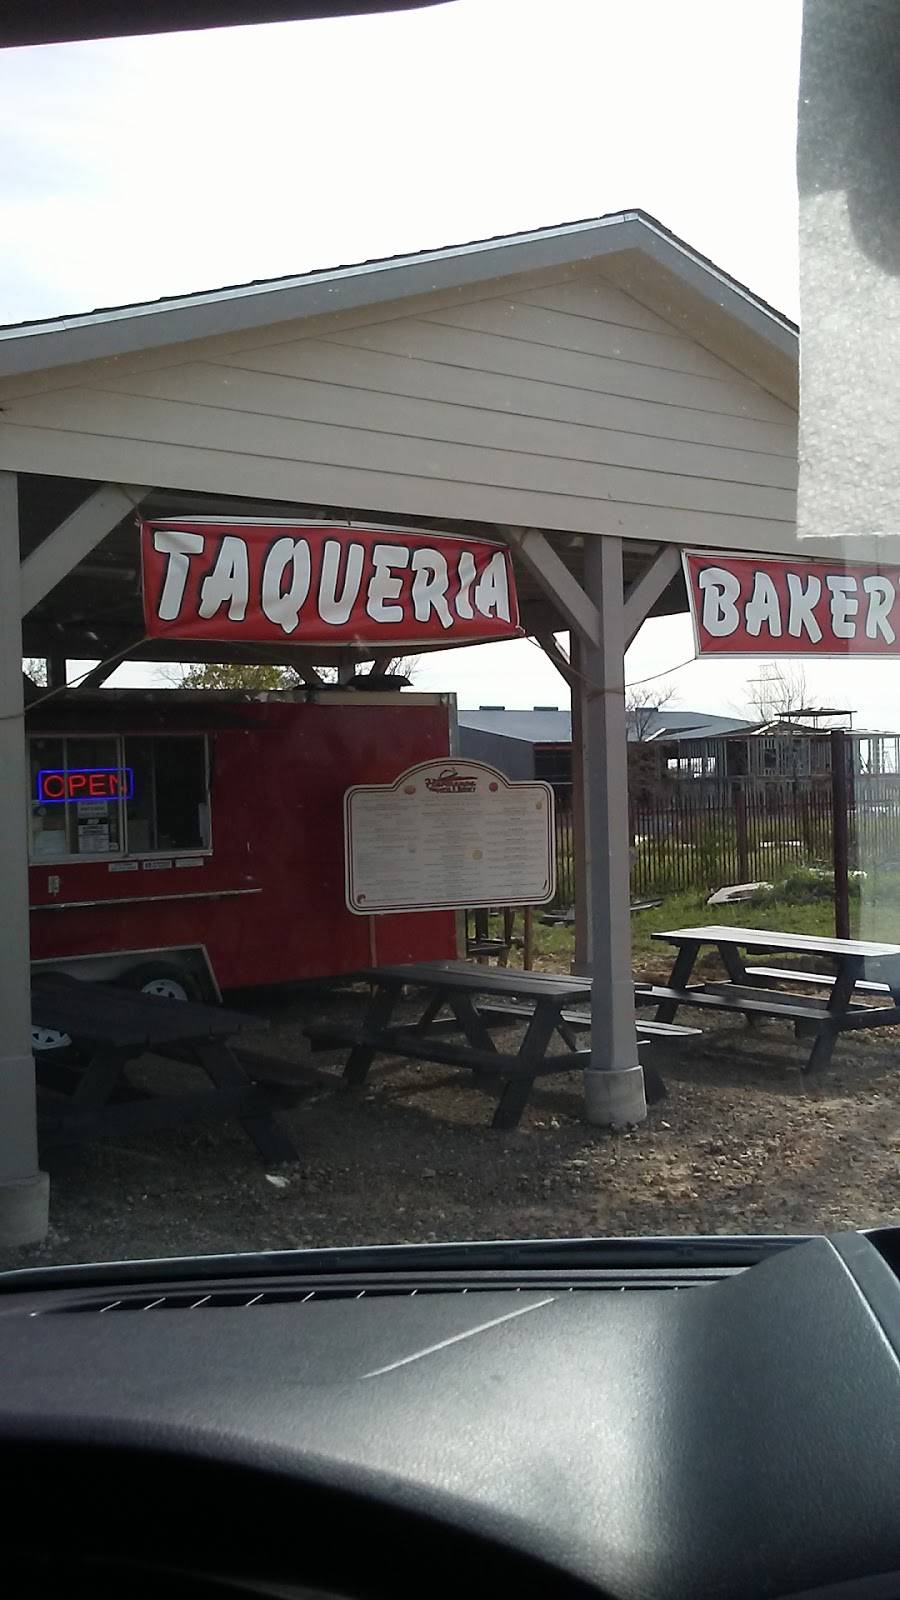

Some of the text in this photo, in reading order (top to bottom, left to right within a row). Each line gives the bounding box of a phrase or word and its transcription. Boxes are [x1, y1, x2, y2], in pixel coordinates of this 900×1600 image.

[152, 529, 512, 635] TAQUERIA
[698, 566, 900, 645] BAKER
[42, 773, 128, 798] OPEN
